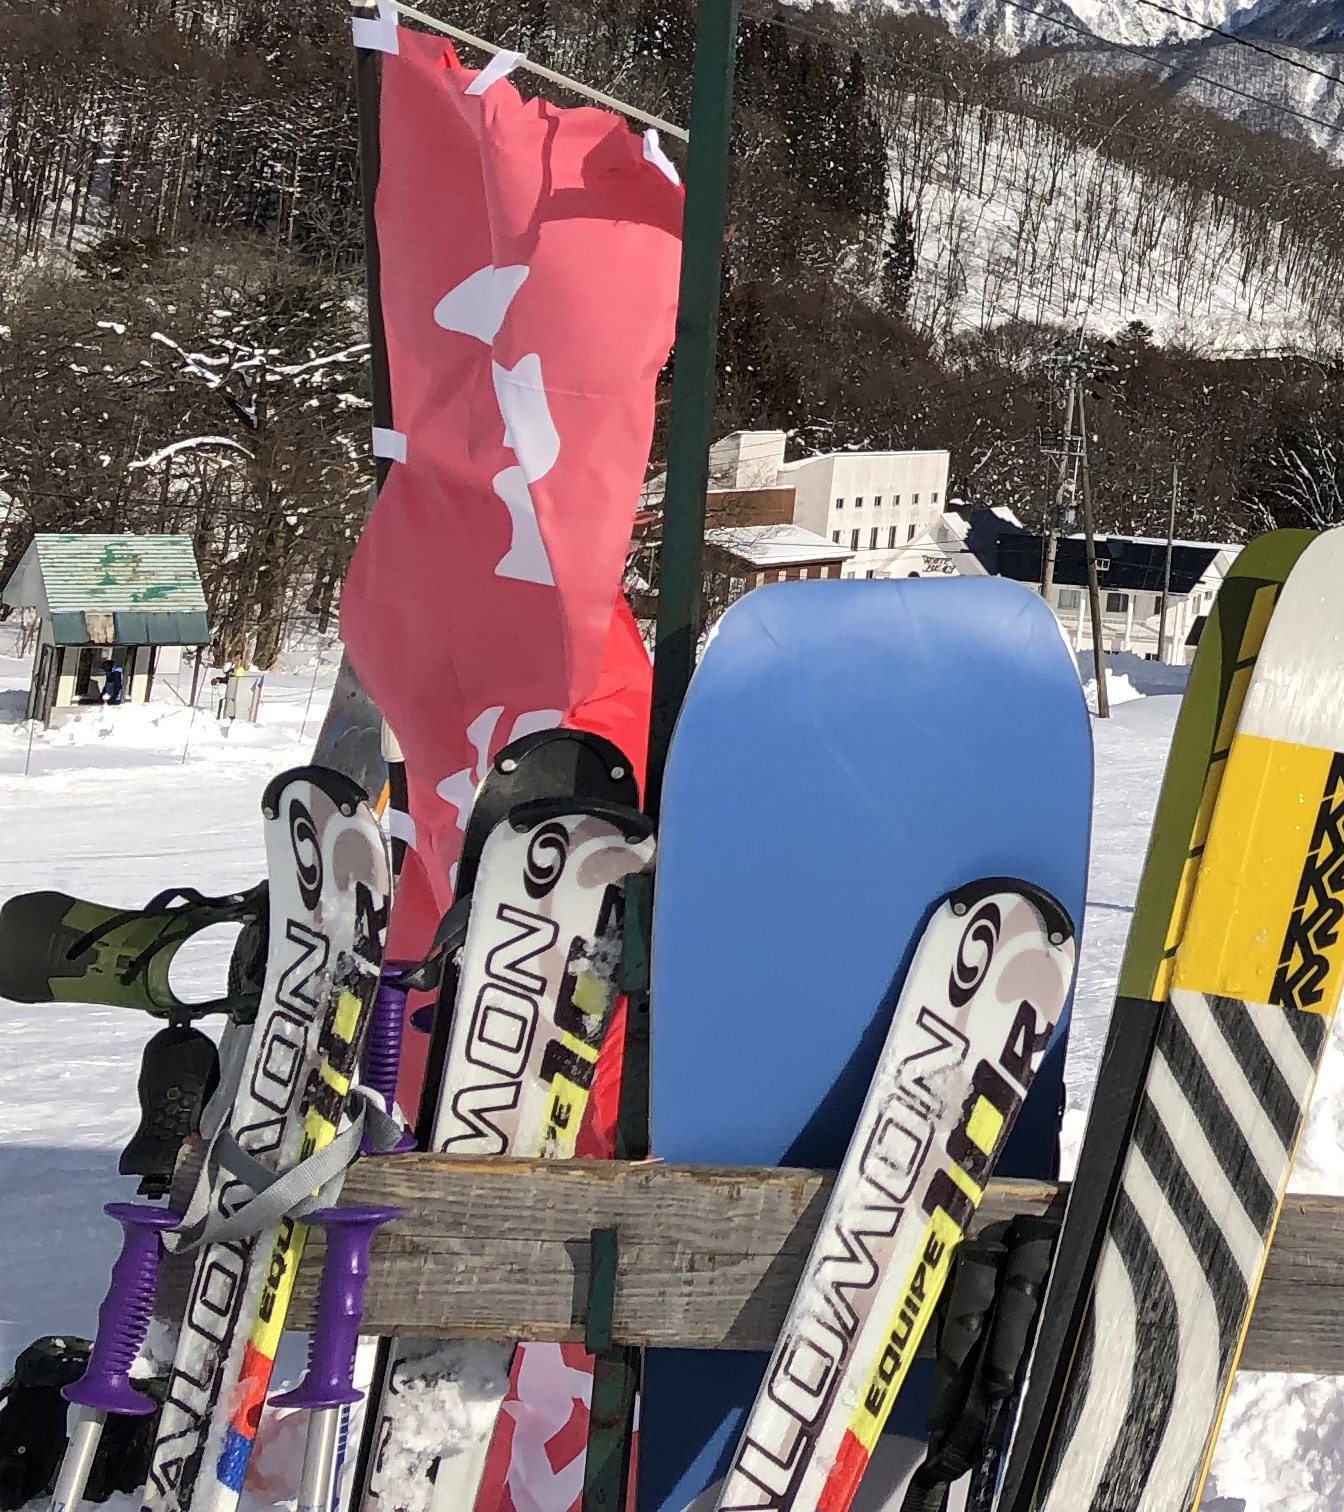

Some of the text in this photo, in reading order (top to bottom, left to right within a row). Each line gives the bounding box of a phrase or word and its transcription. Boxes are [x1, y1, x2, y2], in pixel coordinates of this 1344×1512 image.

[1276, 897, 1344, 968] K2
[1267, 953, 1331, 1009] K2
[862, 1229, 945, 1420] EQUIPE
